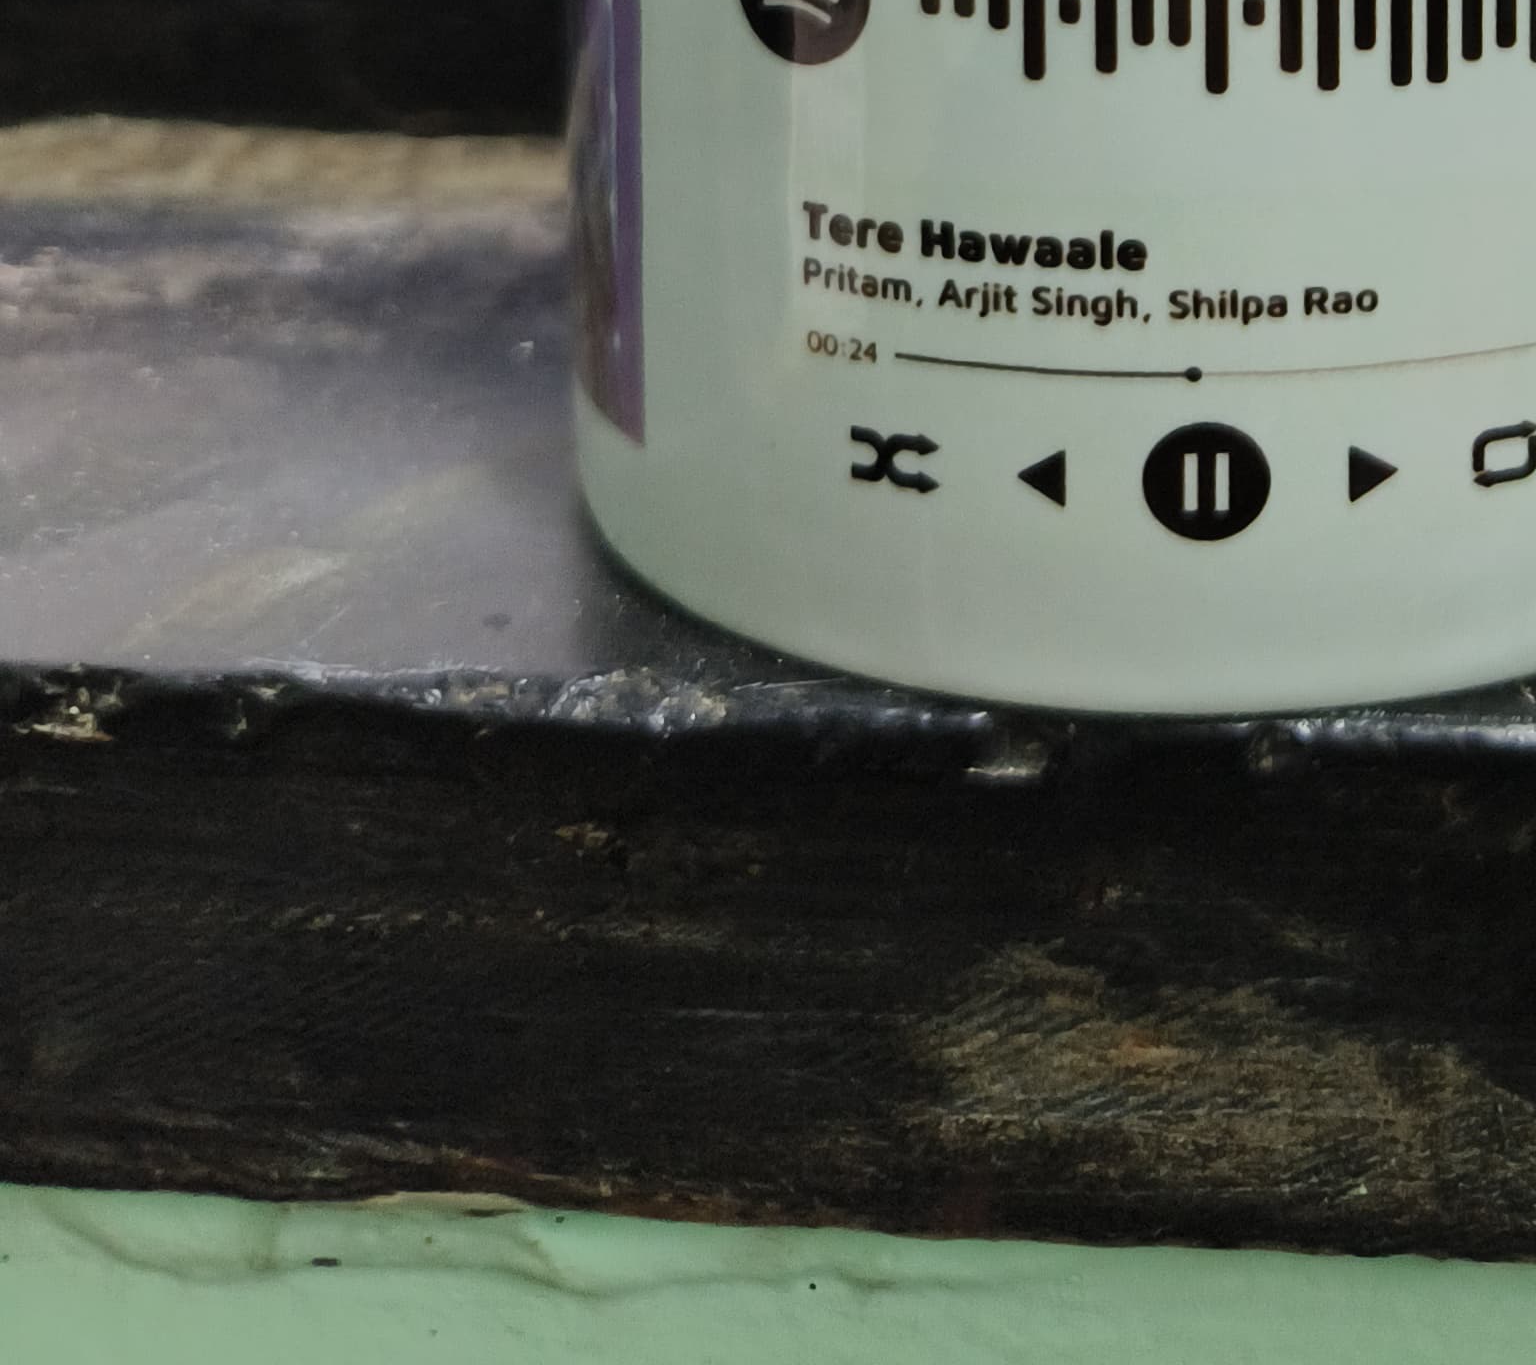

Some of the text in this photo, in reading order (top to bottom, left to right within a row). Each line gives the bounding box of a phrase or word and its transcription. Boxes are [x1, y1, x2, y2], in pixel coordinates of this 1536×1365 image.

[802, 200, 1148, 271] Tere Hawaale
[802, 256, 1380, 327] Pritam, Arjit Singh, Shilpa Rao
[806, 330, 878, 364] 00:24
